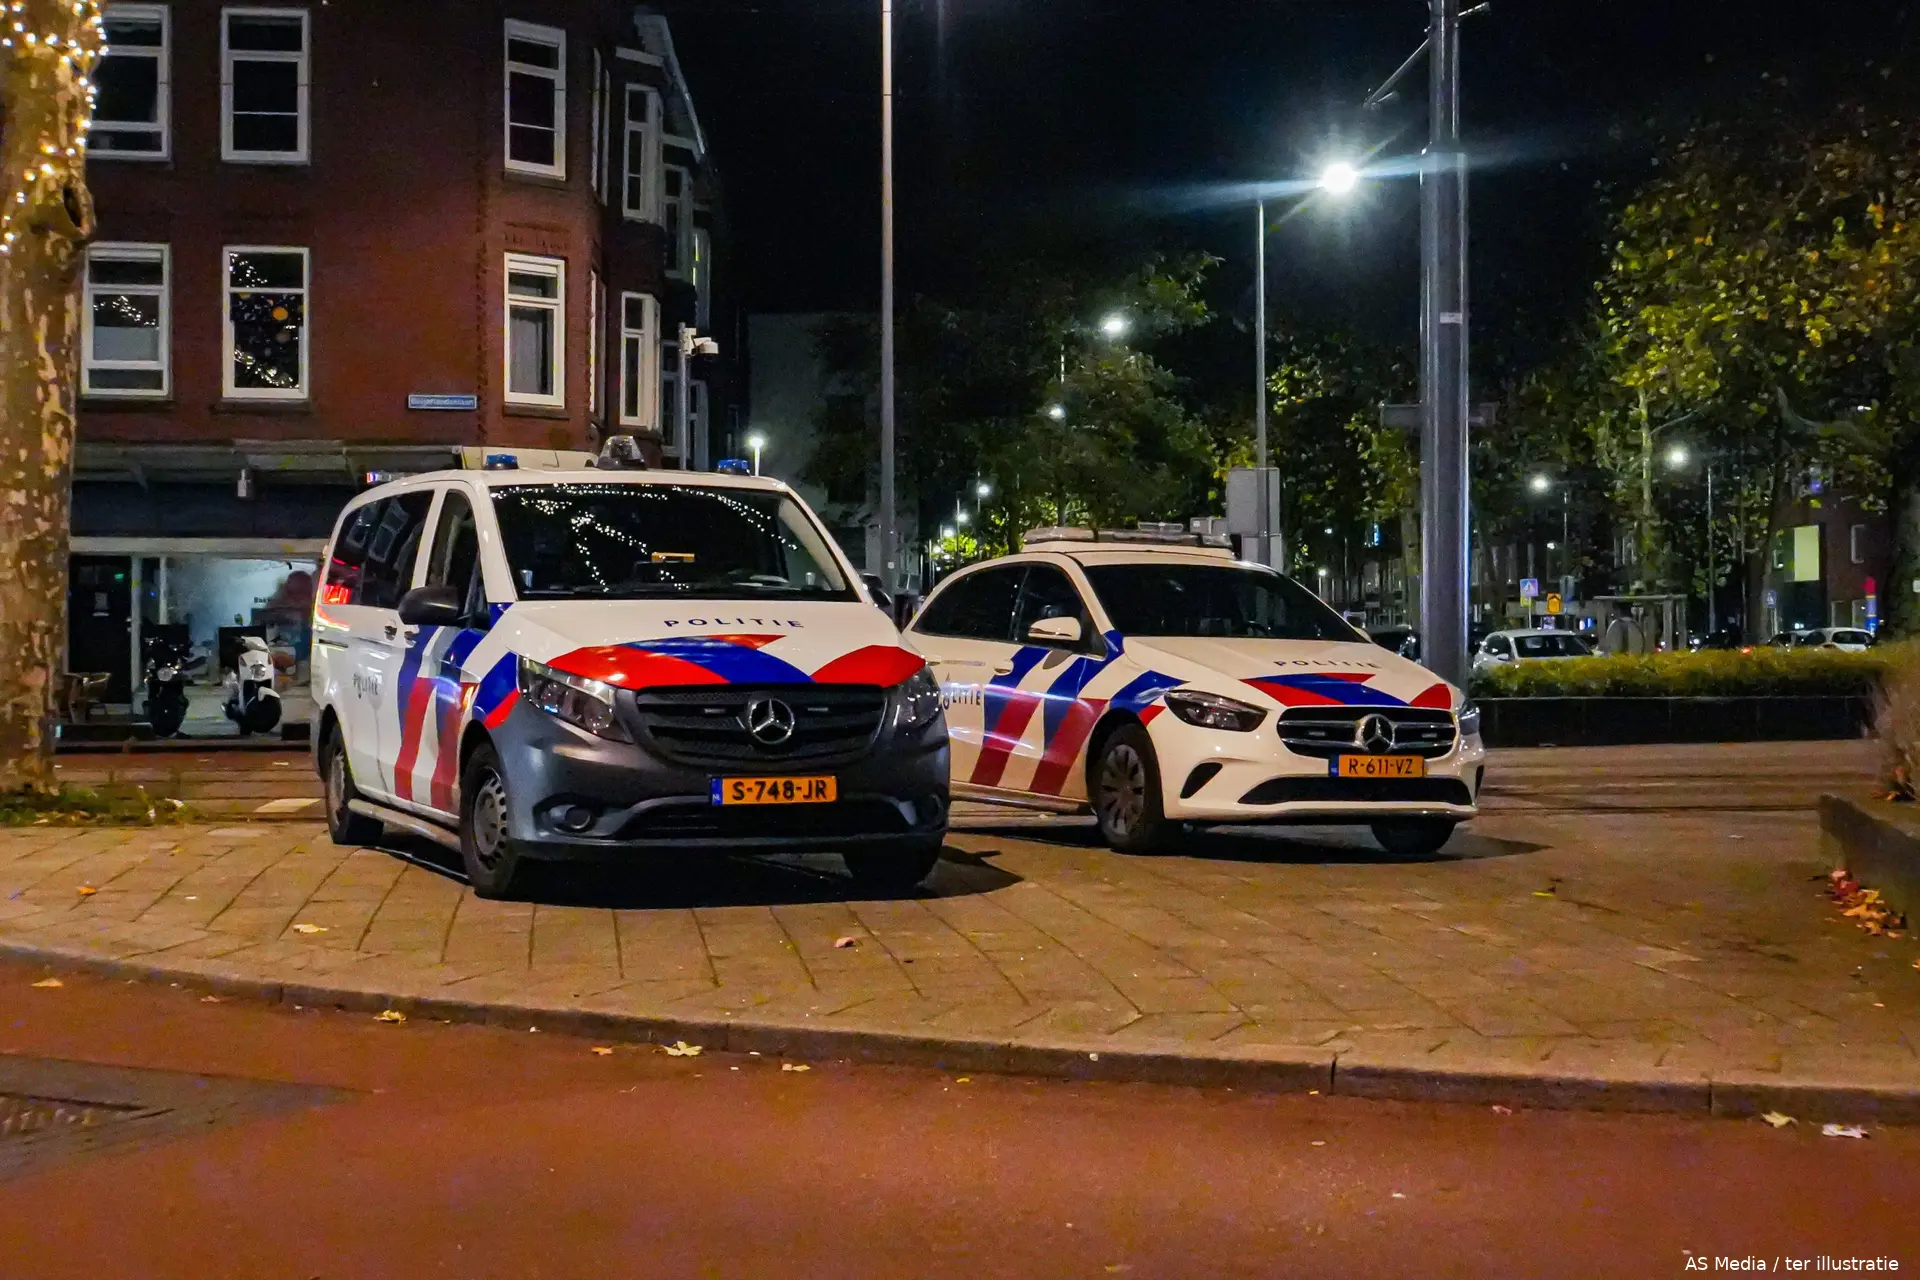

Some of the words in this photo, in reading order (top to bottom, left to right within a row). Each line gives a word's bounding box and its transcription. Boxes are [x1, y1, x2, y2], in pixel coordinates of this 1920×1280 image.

[663, 618, 804, 628] POLITIE
[1273, 660, 1382, 669] POLITIE
[942, 689, 982, 710] OLITIE
[1348, 758, 1413, 775] R-611-VZ
[732, 779, 827, 801] S-748-JR
